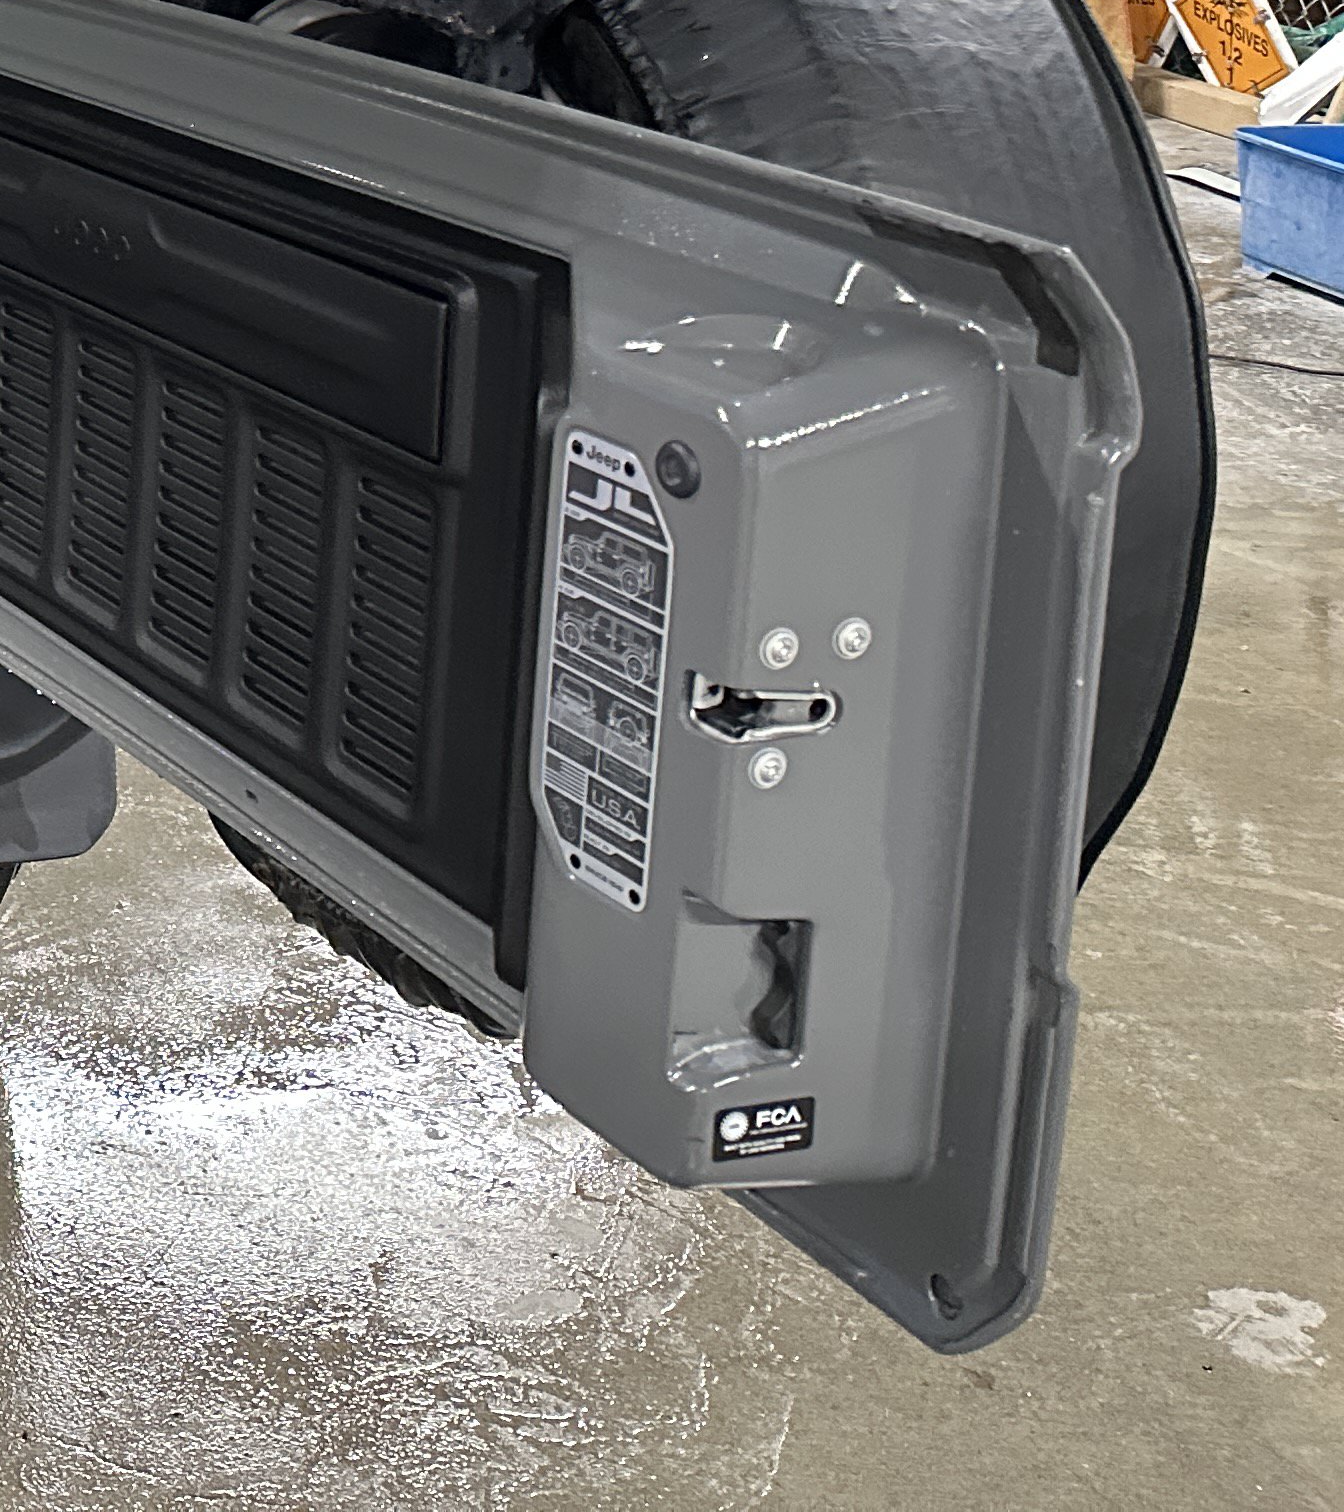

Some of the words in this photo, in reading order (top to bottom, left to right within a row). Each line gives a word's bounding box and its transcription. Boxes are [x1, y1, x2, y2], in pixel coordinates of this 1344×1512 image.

[1193, 0, 1269, 58] EXPLOSIVES
[1218, 39, 1244, 66] 1.2
[586, 445, 621, 473] Jeep
[567, 478, 657, 527] JL
[591, 788, 641, 831] USA
[755, 1104, 802, 1129] FCA
